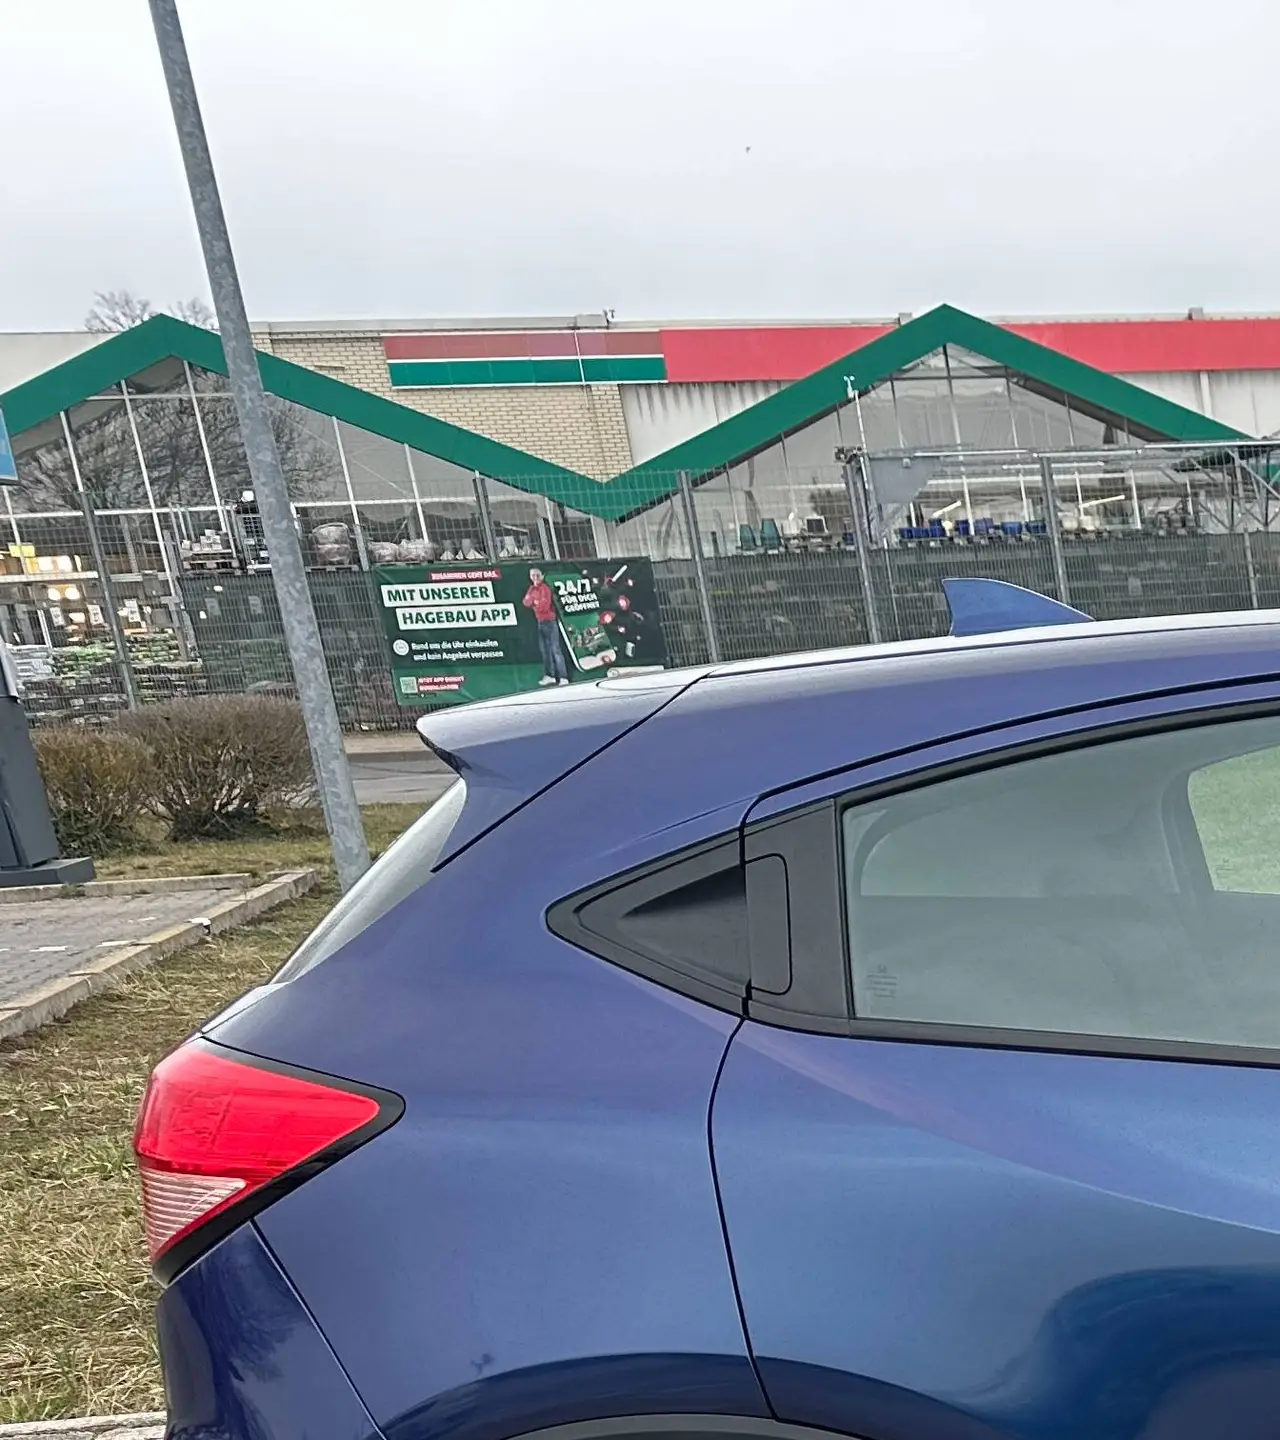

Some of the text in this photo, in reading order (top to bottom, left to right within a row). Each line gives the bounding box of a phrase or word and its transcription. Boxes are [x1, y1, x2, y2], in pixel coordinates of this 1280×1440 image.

[387, 586, 490, 602] MIT UNSERER
[401, 608, 511, 625] HAGEBAU APP
